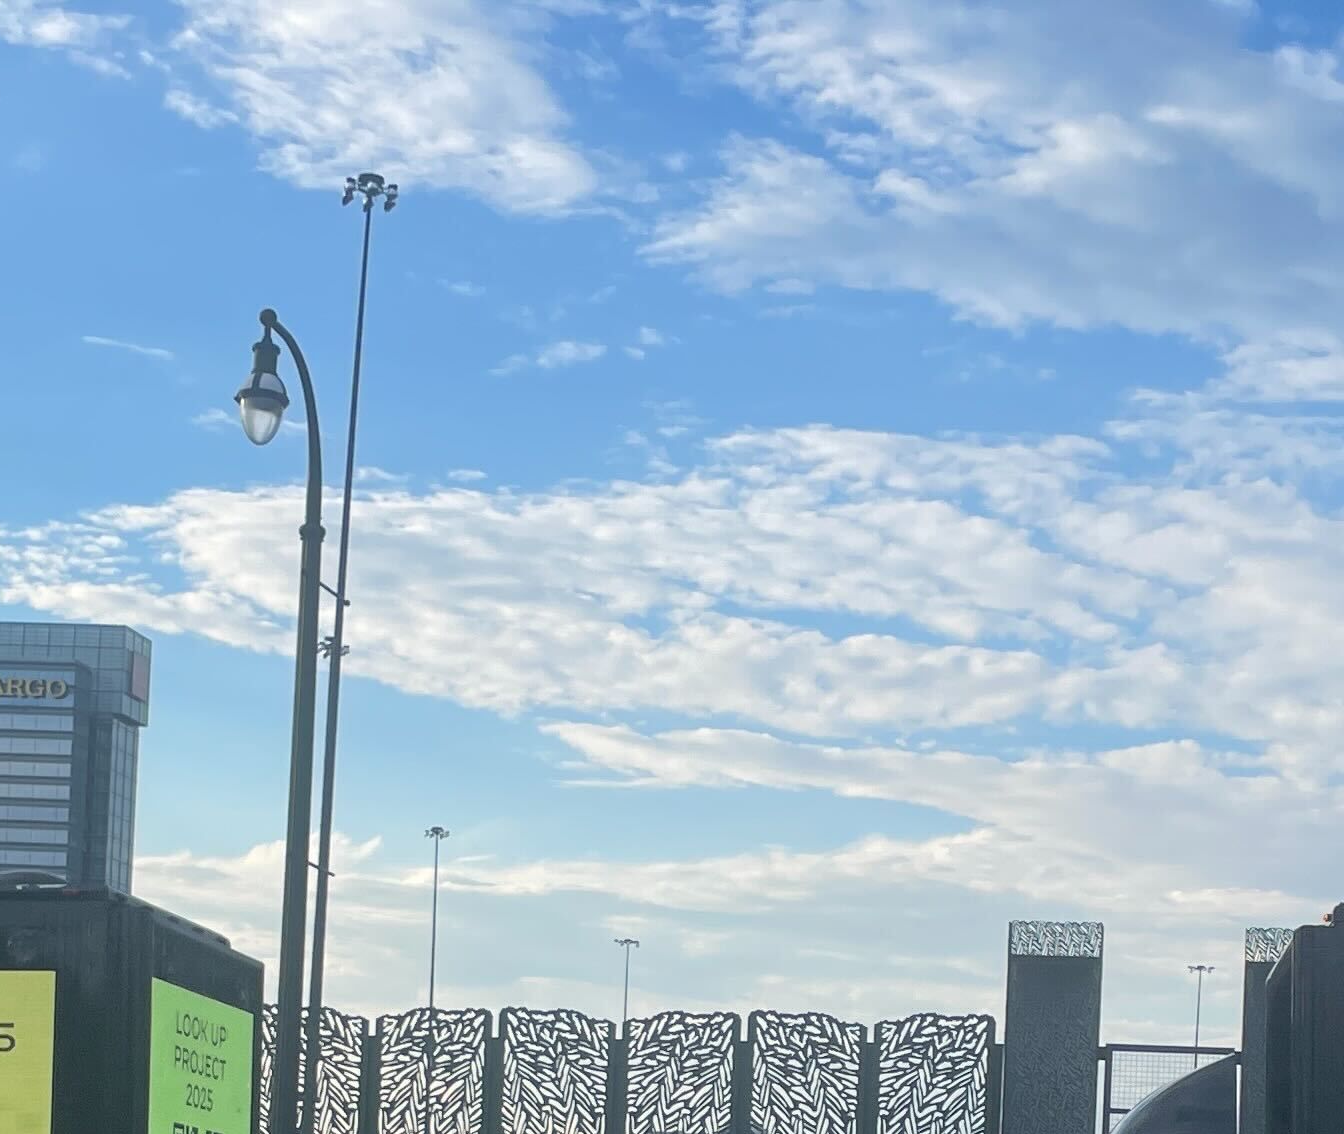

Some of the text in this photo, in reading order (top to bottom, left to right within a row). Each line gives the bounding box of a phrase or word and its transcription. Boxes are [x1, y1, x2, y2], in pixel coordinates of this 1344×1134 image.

[175, 1011, 227, 1047] LOOK UP
[174, 1045, 227, 1081] PROJECT
[185, 1083, 214, 1113] 2025
